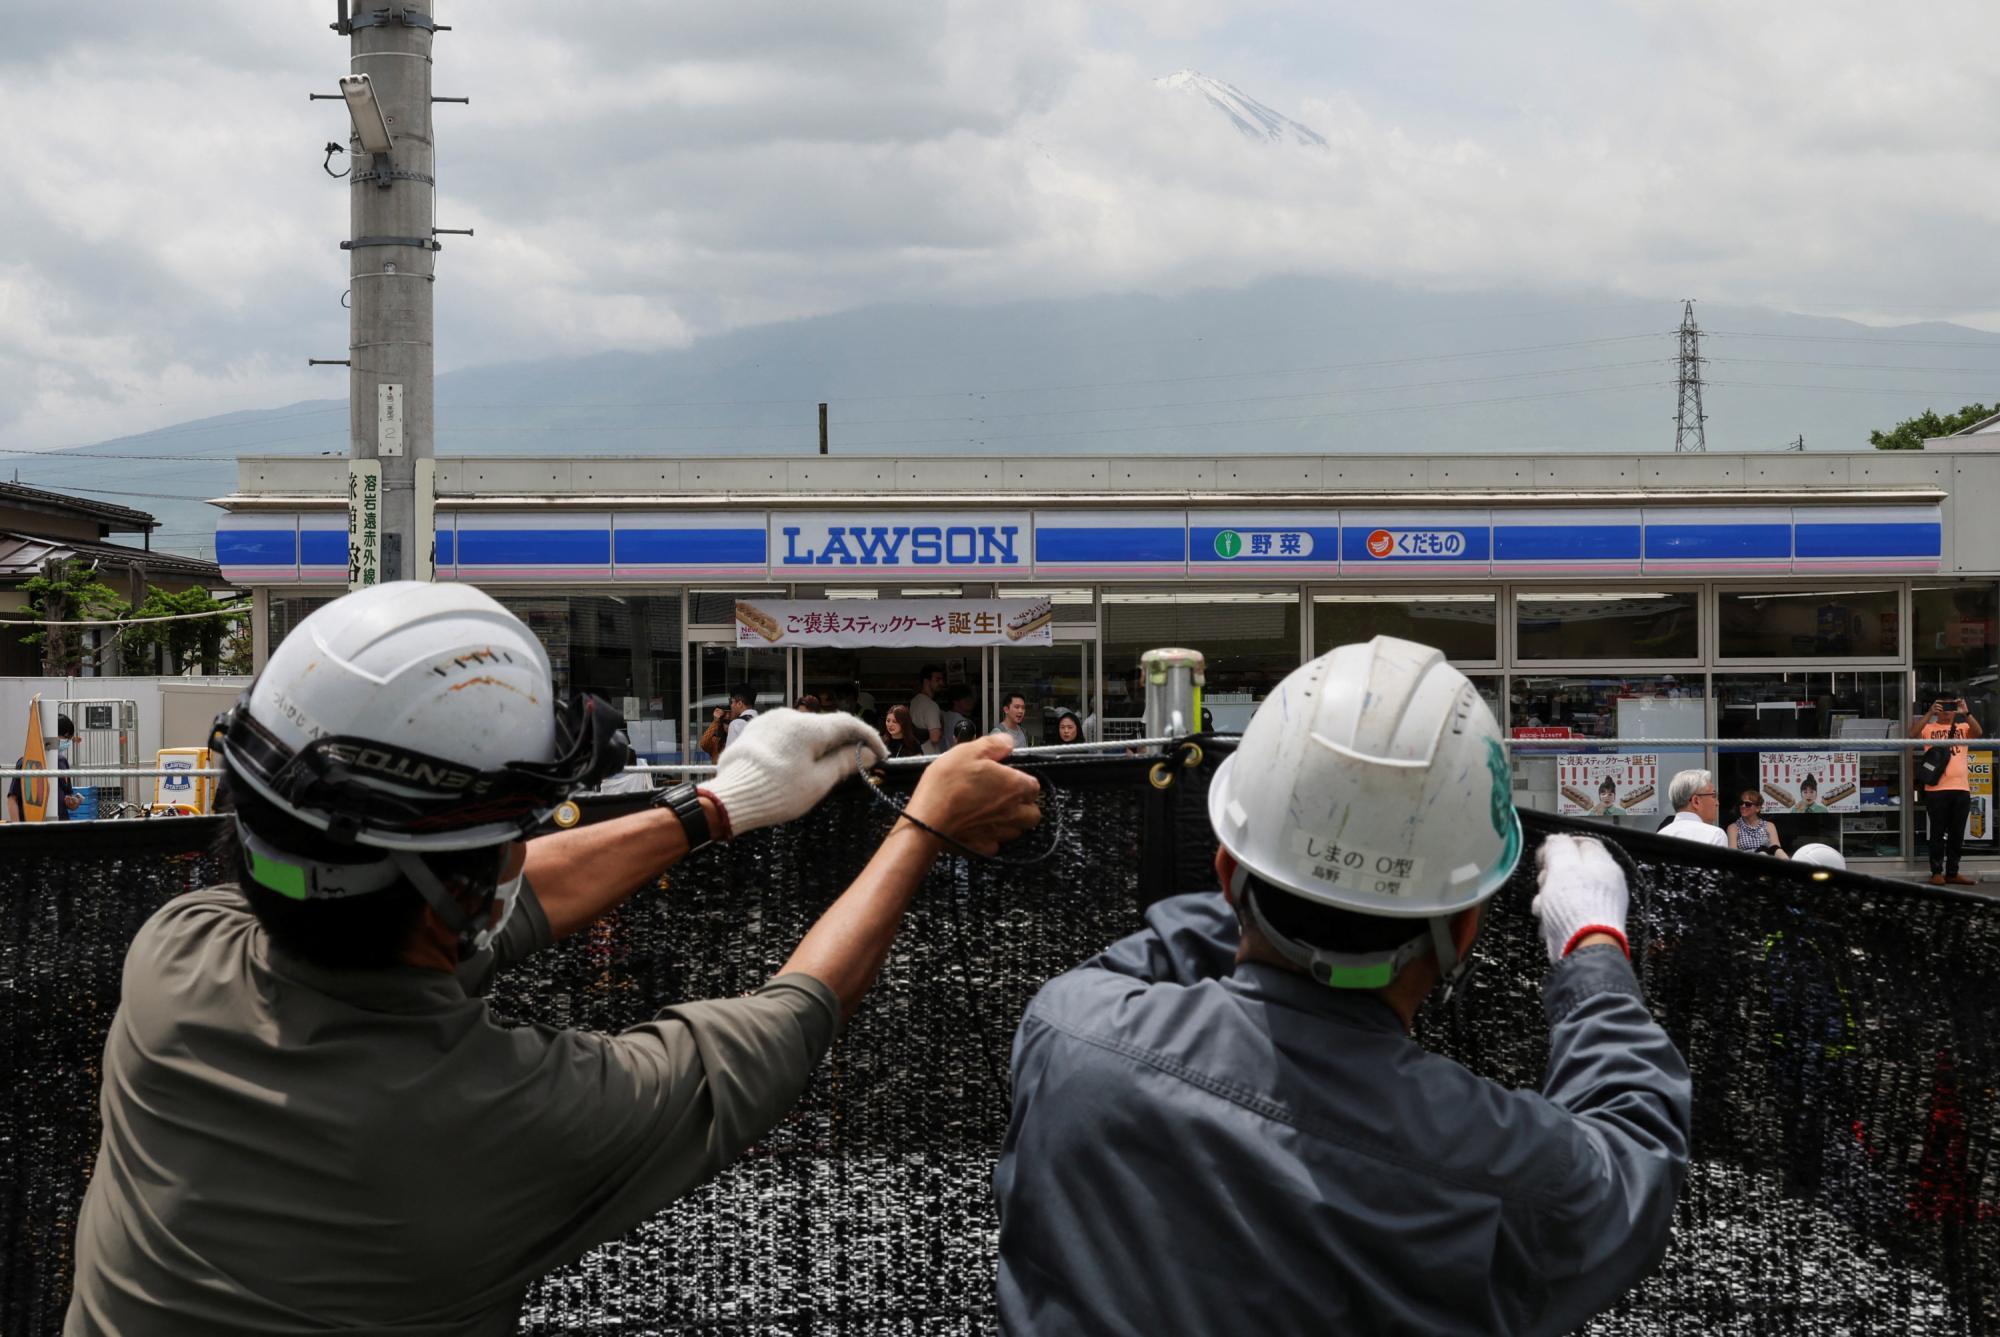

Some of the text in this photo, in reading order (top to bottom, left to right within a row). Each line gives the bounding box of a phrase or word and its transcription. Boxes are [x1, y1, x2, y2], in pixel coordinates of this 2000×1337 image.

[363, 474, 377, 585] 溶岩遠赤外線
[783, 527, 1018, 564] LAWSON
[1251, 534, 1301, 555] 野菜
[1398, 534, 1460, 554] くだもの
[1307, 838, 1414, 878] しまの O型
